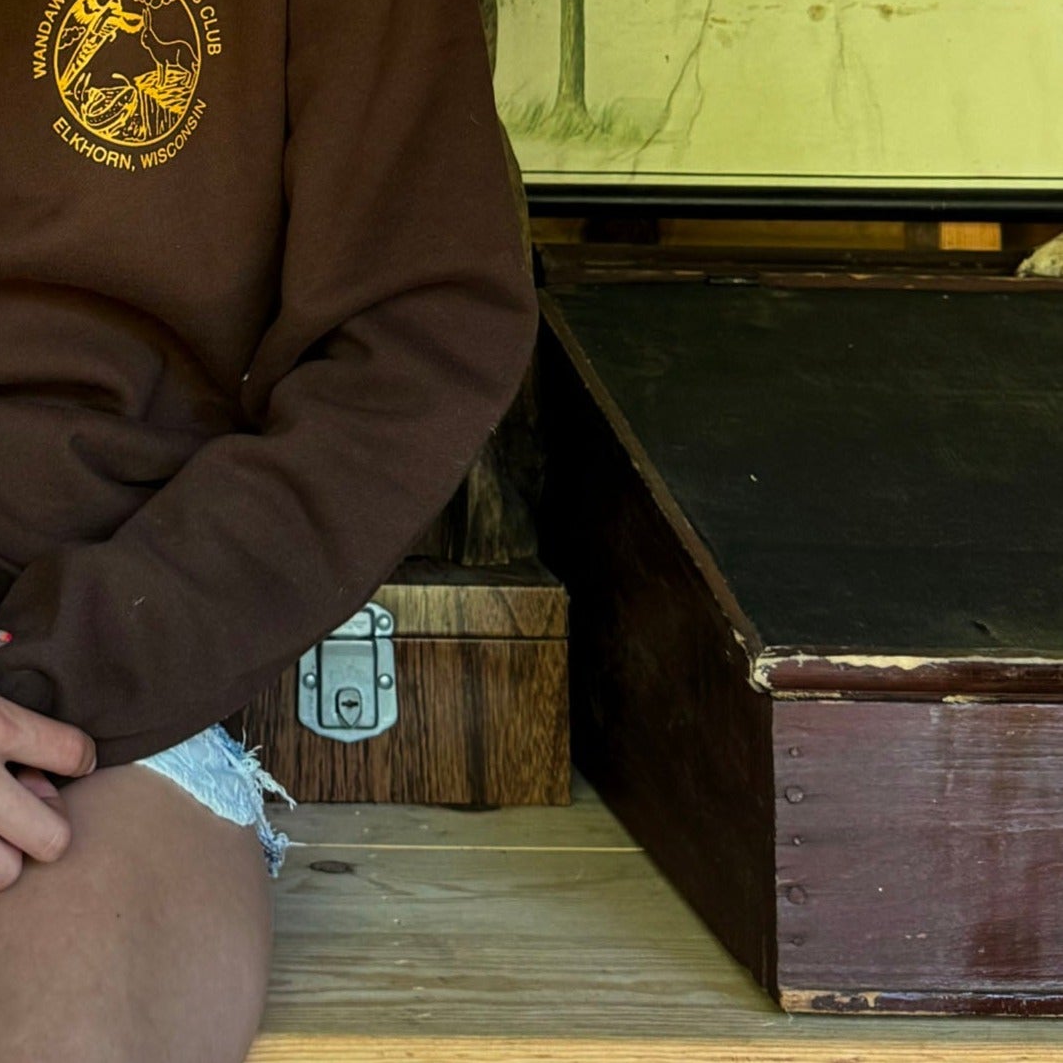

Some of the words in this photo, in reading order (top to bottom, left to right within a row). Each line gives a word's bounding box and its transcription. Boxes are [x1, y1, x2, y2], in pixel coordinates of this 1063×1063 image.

[200, 6, 221, 55] CLUB
[52, 117, 136, 172] ELKHORN,
[140, 99, 207, 169] WISCONSIN
